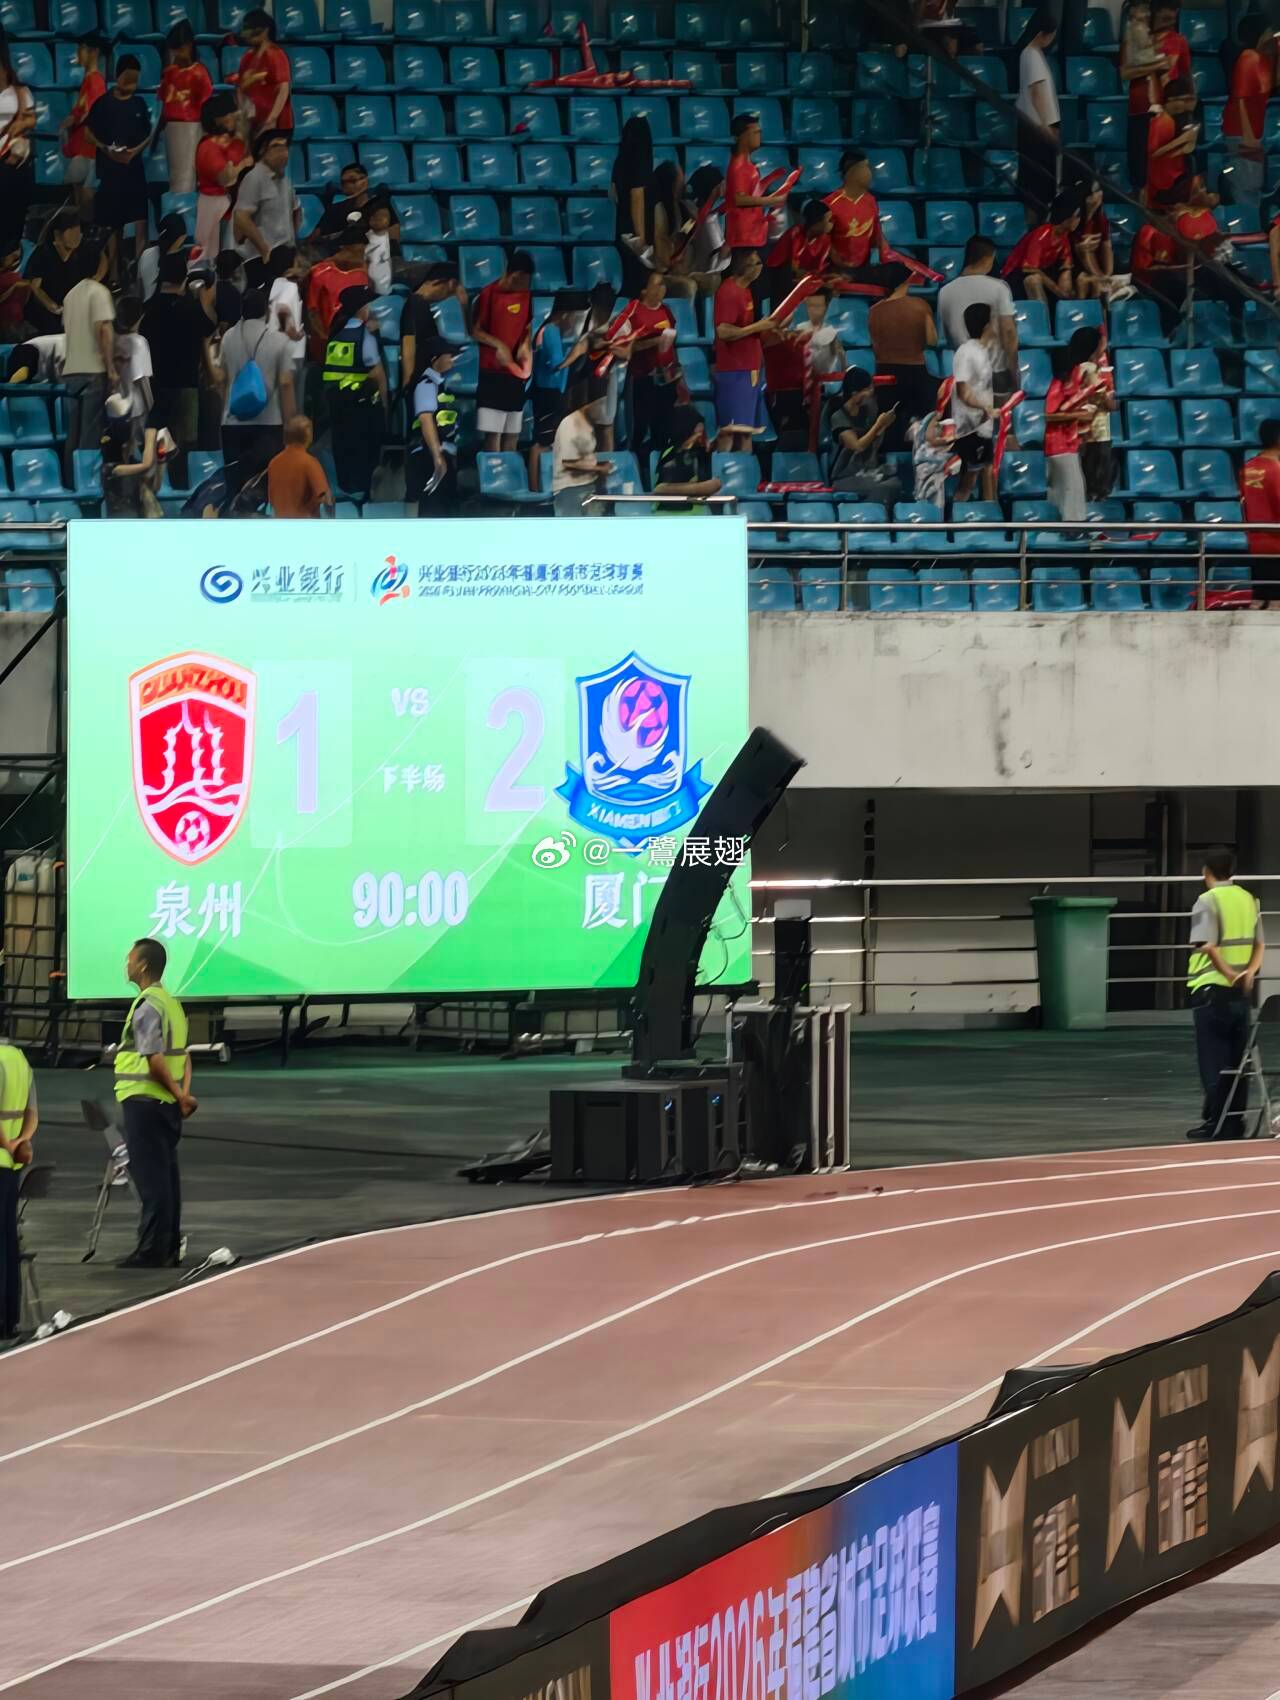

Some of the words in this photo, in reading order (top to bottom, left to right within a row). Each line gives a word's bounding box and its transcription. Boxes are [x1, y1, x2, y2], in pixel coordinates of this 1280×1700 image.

[251, 564, 345, 594] 兴业银行
[391, 687, 430, 717] VS
[276, 689, 318, 814] 1
[484, 687, 547, 813] 2
[383, 764, 447, 794] 下半场
[147, 880, 242, 939] 泉州
[352, 871, 469, 928] 90:00
